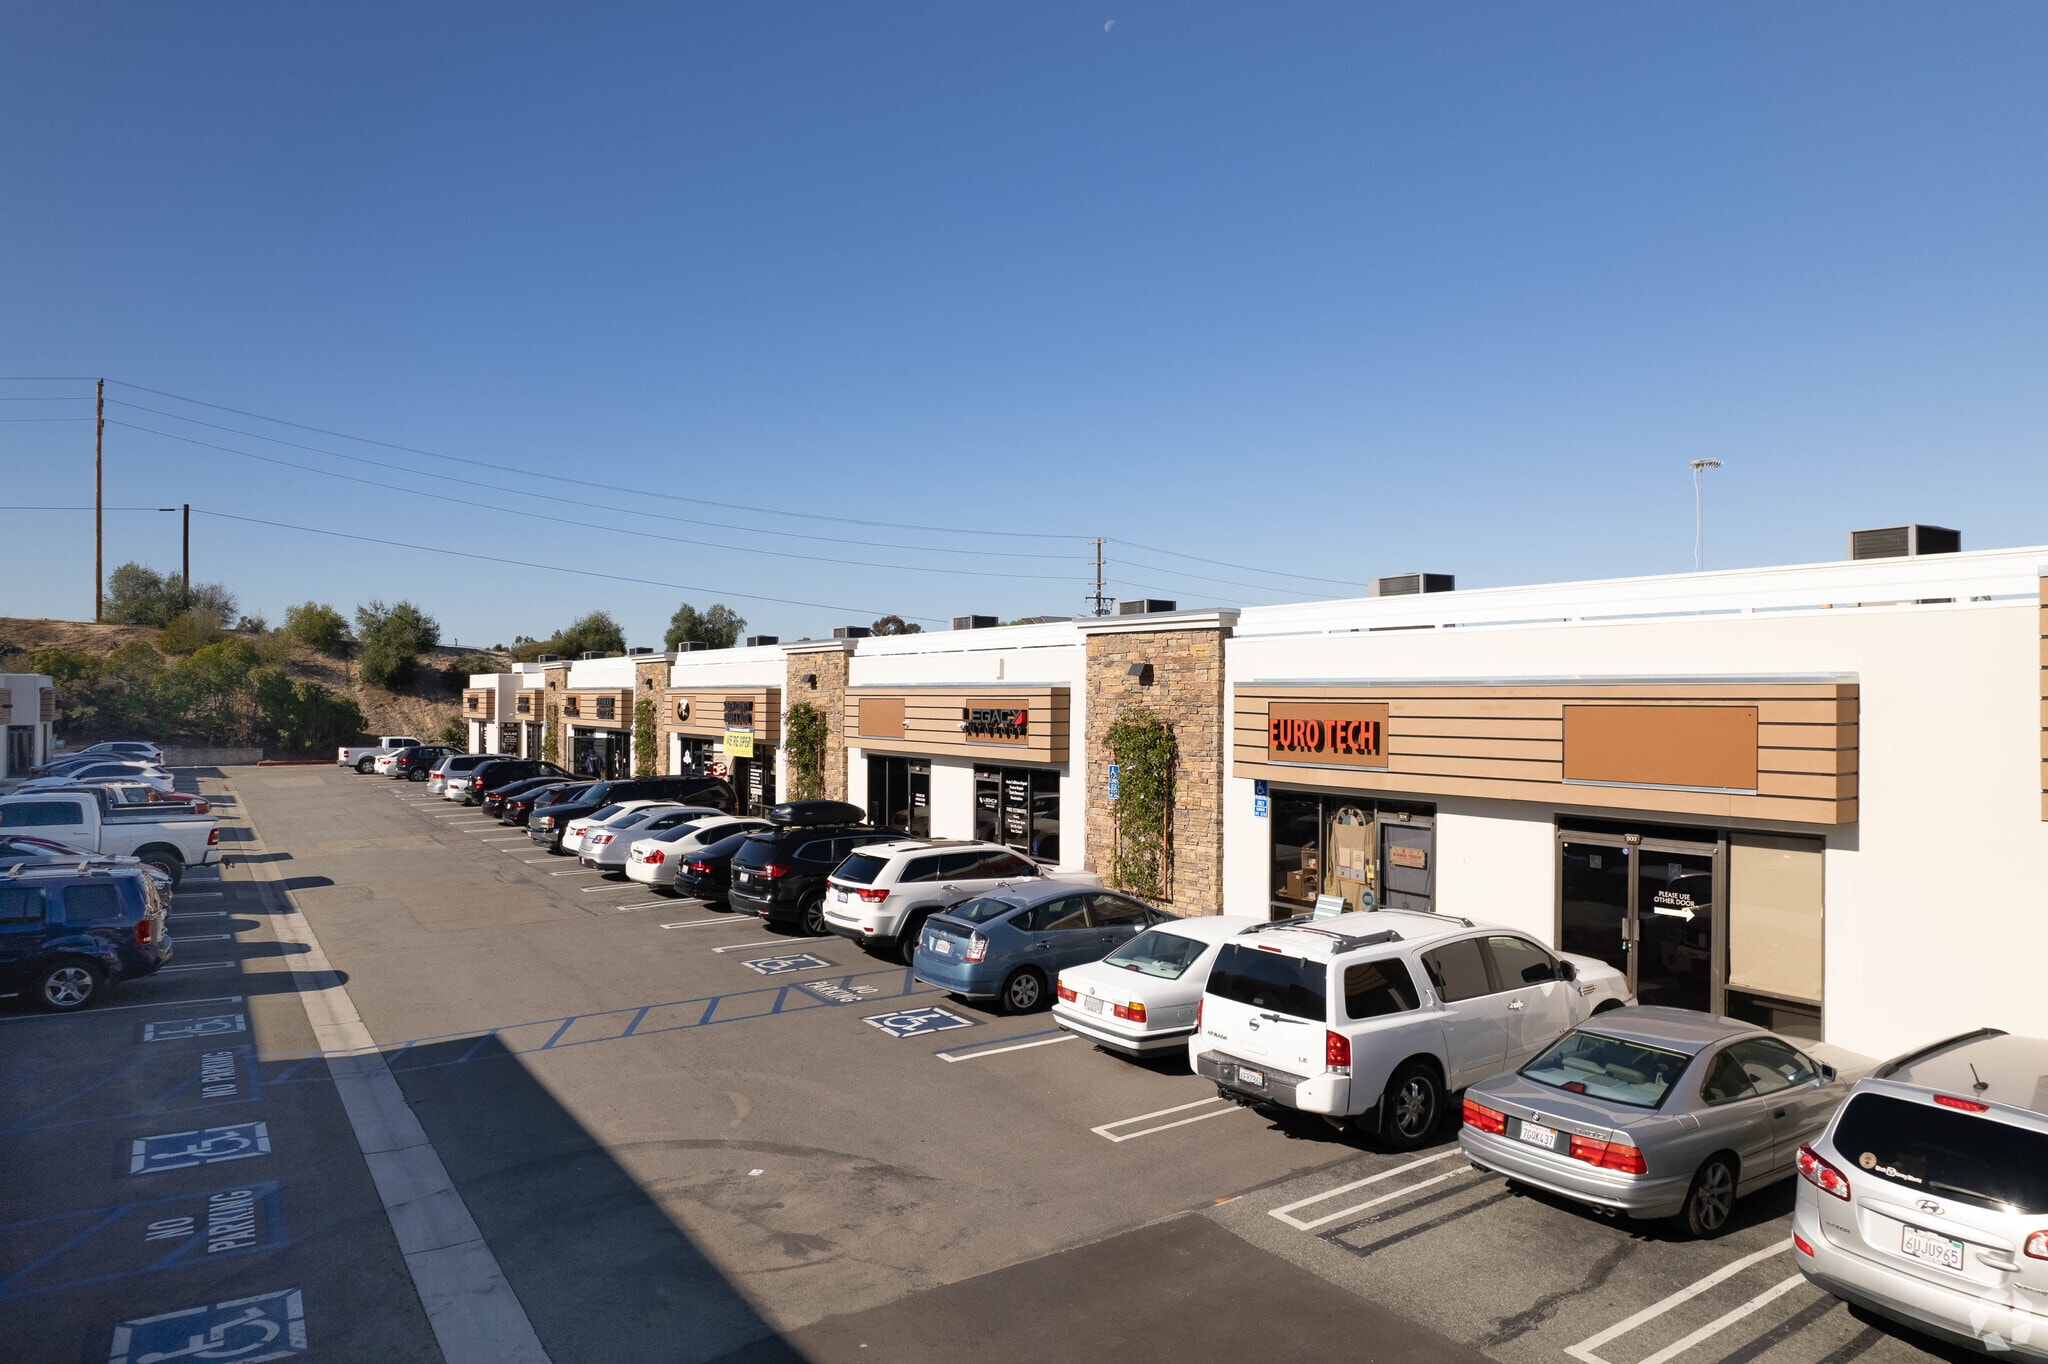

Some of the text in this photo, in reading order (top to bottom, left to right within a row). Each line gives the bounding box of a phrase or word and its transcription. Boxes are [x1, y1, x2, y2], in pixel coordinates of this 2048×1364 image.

[962, 708, 1022, 725] LEGACY
[1269, 718, 1374, 750] EURO TECH
[1653, 896, 1695, 908] OTHER DOOR
[1658, 890, 1691, 900] PLEASE USE
[804, 980, 863, 1003] PARKING
[848, 984, 880, 994] NO
[201, 1051, 238, 1099] NO PARKING
[145, 1216, 194, 1241] NO
[207, 1190, 256, 1253] PARKING
[1905, 1236, 1959, 1264] 6UJU965
